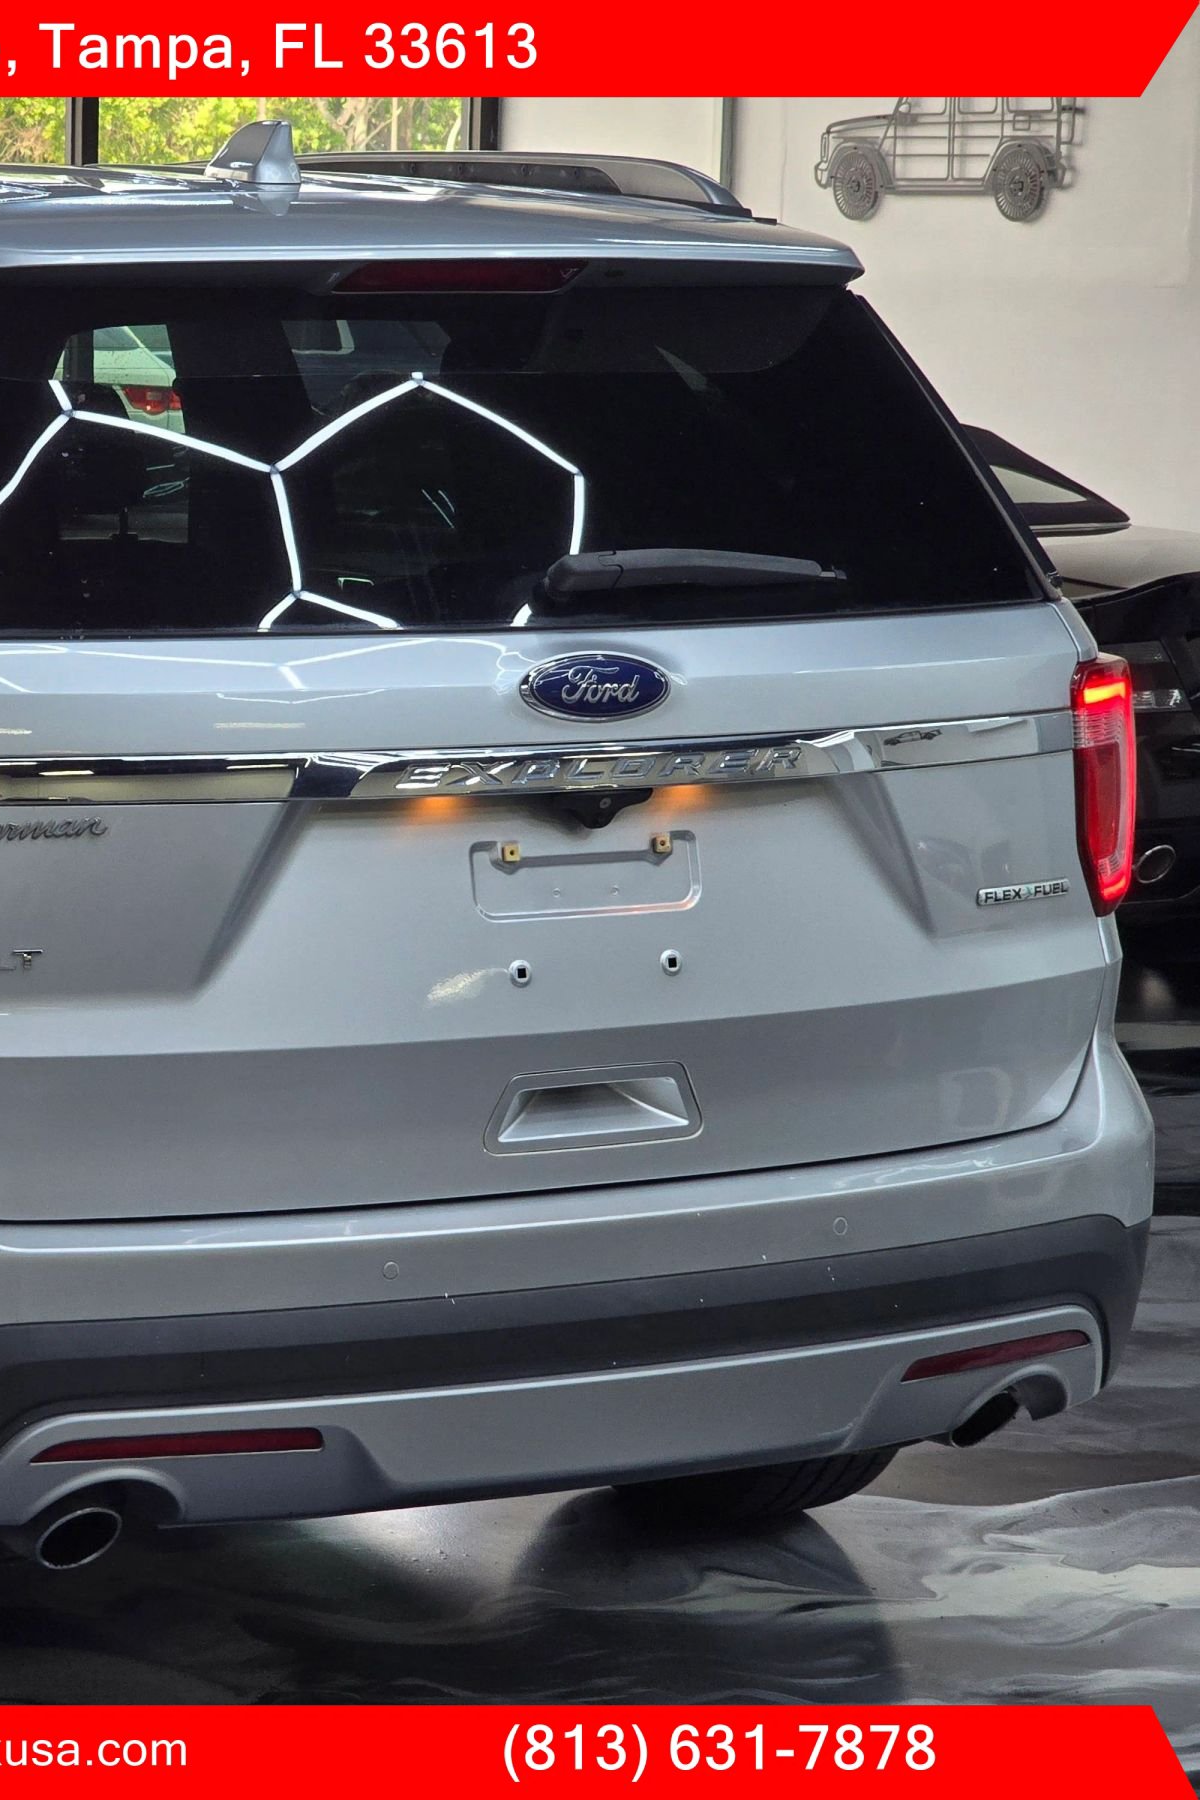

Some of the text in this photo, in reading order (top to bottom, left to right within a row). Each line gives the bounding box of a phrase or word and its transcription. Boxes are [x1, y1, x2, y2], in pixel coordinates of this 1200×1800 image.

[560, 664, 641, 705] Ford
[395, 747, 802, 789] EXPLORER
[984, 881, 1069, 903] FLEX FUEL
